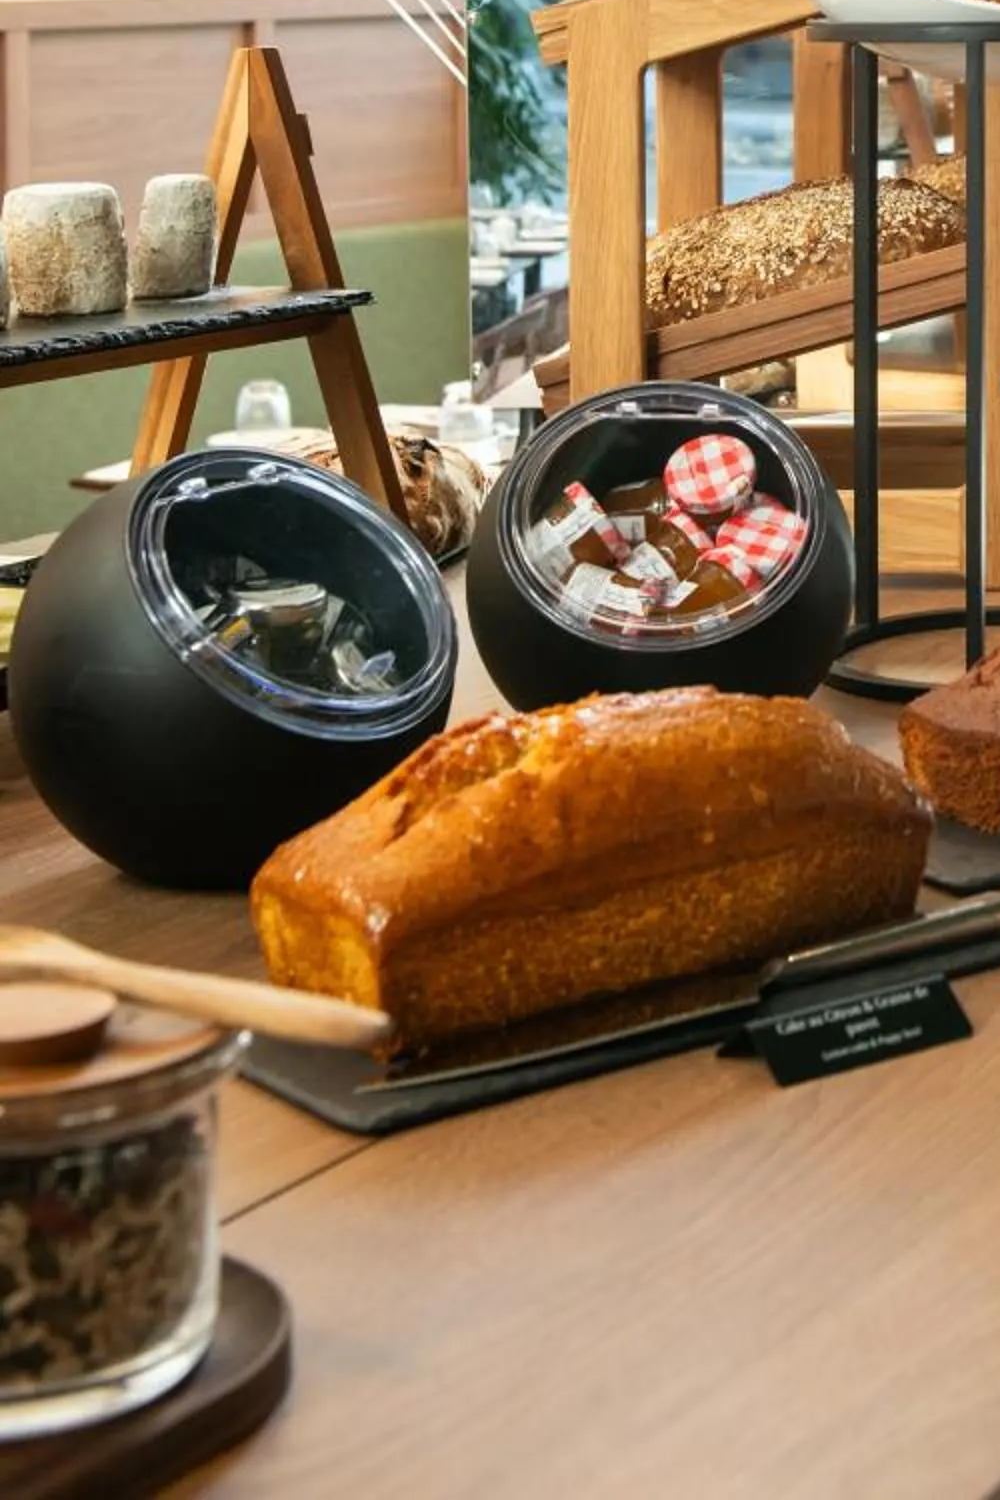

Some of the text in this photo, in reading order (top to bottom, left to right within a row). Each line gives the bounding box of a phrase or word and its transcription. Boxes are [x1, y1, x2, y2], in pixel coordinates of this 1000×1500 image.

[776, 1017, 805, 1035] Cake
[825, 1004, 862, 1023] Citron
[863, 1000, 873, 1012] &
[915, 986, 929, 998] de
